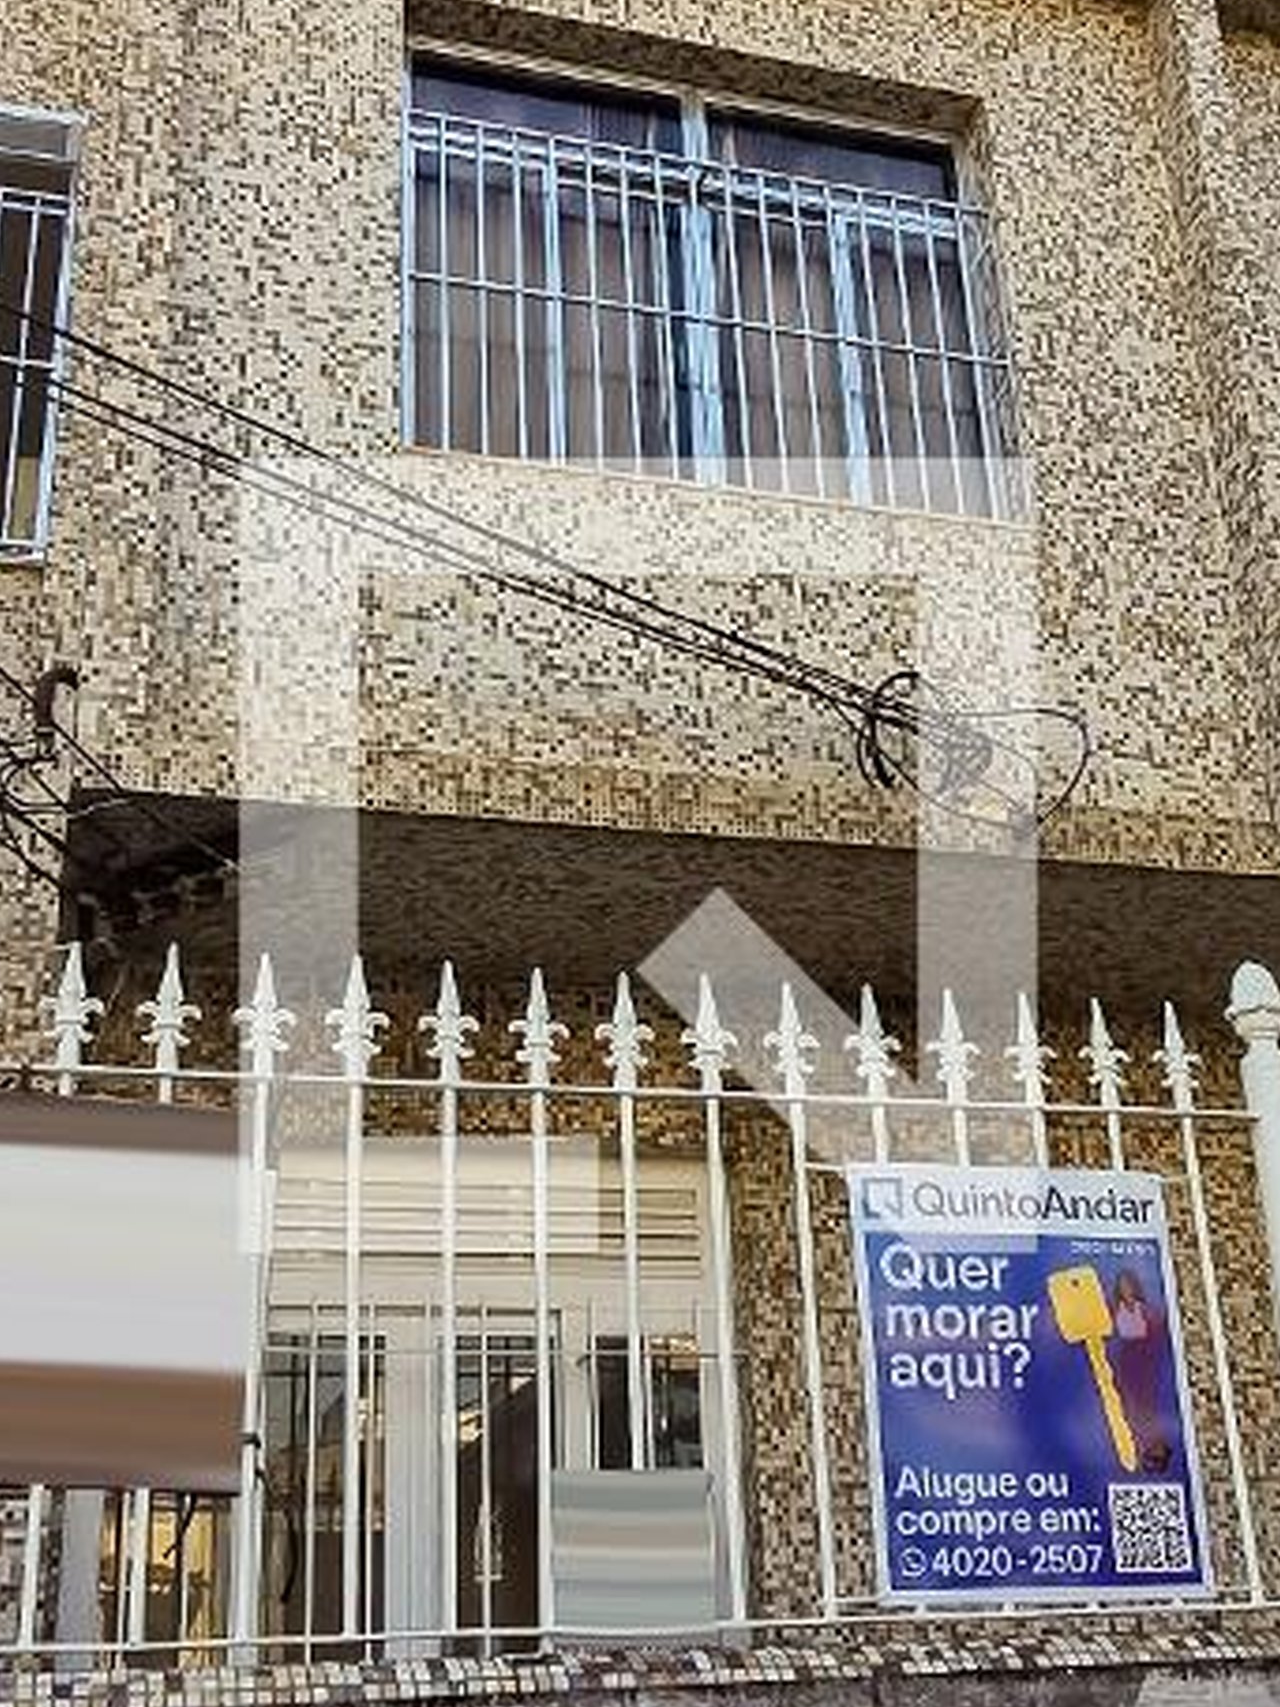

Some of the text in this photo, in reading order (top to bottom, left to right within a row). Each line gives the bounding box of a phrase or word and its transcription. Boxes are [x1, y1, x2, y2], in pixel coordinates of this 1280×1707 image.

[912, 1181, 1155, 1224] QuintoAndar
[879, 1243, 1010, 1292] Quer
[885, 1301, 1039, 1342] morar
[889, 1342, 1032, 1399] aqui?
[894, 1466, 1070, 1505] Alugue ou
[896, 1506, 1102, 1541] compre em:
